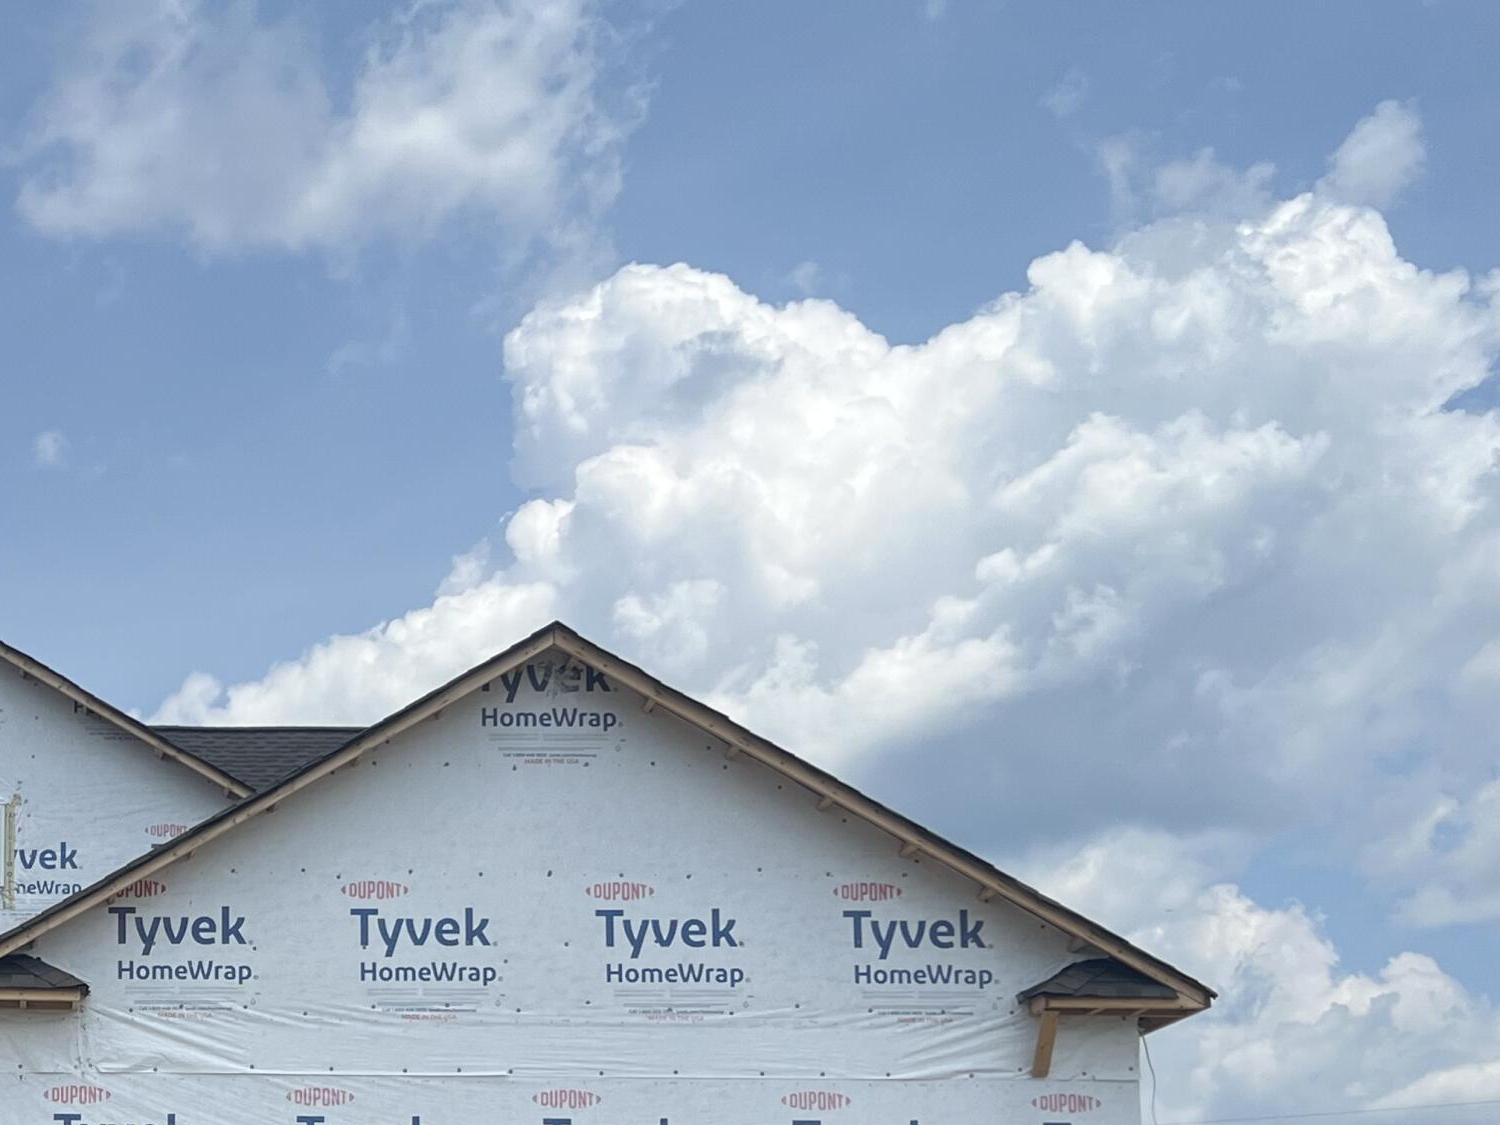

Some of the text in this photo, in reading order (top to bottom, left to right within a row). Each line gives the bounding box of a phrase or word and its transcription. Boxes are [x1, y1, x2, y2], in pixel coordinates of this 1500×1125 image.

[482, 664, 611, 703] yvek
[481, 707, 617, 732] HomeWrap
[150, 824, 188, 837] DUPONT
[14, 842, 78, 870] vek
[15, 880, 82, 895] meWrap
[116, 880, 160, 899] UPONT
[348, 880, 402, 899] DUPONT
[593, 882, 648, 900] DUPONT
[841, 883, 895, 901] DUPONT
[108, 906, 247, 955] Tyvek
[350, 907, 491, 957] Tyvek
[595, 908, 738, 958] Tyvek
[842, 909, 986, 959] Tyvek
[117, 959, 253, 985] HomeWrap
[360, 961, 497, 986] HomeWrap
[606, 962, 745, 987] HomeWrap
[853, 964, 994, 989] HomeWrap
[51, 1086, 104, 1104] DUPONT
[294, 1088, 348, 1106] DUPONT
[541, 1089, 595, 1109] DUPONT
[789, 1091, 845, 1110] DUPONT
[1040, 1093, 1094, 1113] DUPONT
